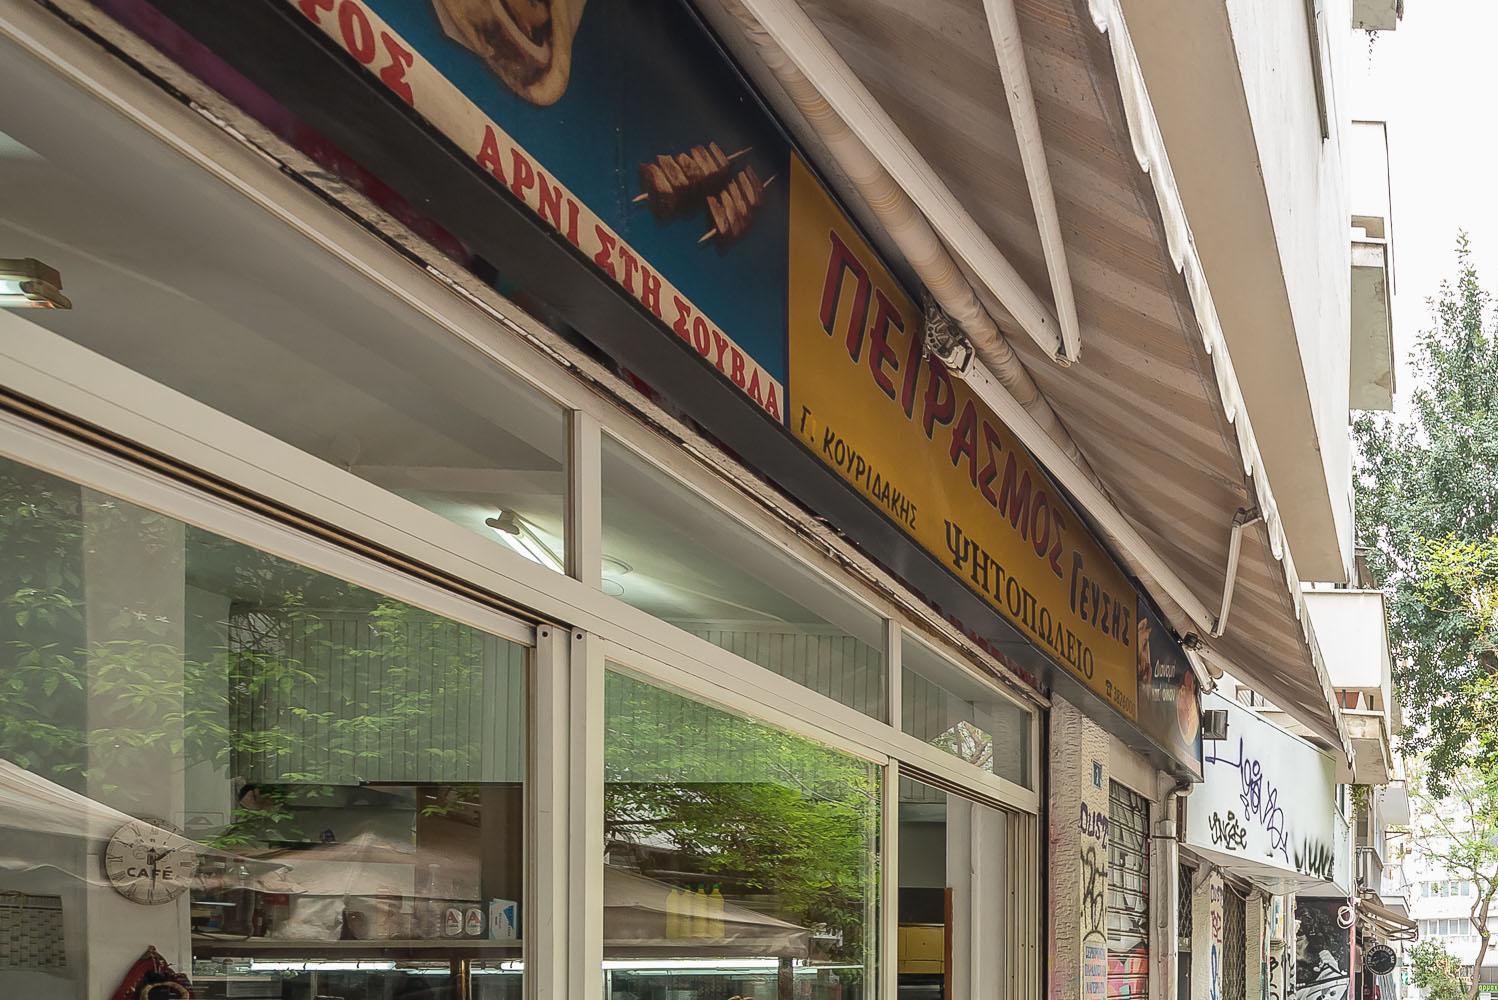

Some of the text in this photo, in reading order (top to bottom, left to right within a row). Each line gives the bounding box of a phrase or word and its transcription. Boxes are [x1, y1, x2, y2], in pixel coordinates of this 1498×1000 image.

[476, 124, 781, 421] ΑΡΝΙ ΣΤΗ ΣΟΥΒΛΑ
[819, 229, 1131, 647] ΠΕΙΡΑΣΜΟΣ ΓΕΥΣΗΣ
[823, 426, 918, 531] ΚΟΥΡΙΔΑΚΗΣ
[943, 518, 1095, 681] ΨΗΤΟΠΩΛΕΙΟ
[126, 866, 173, 880] CAFÉ
